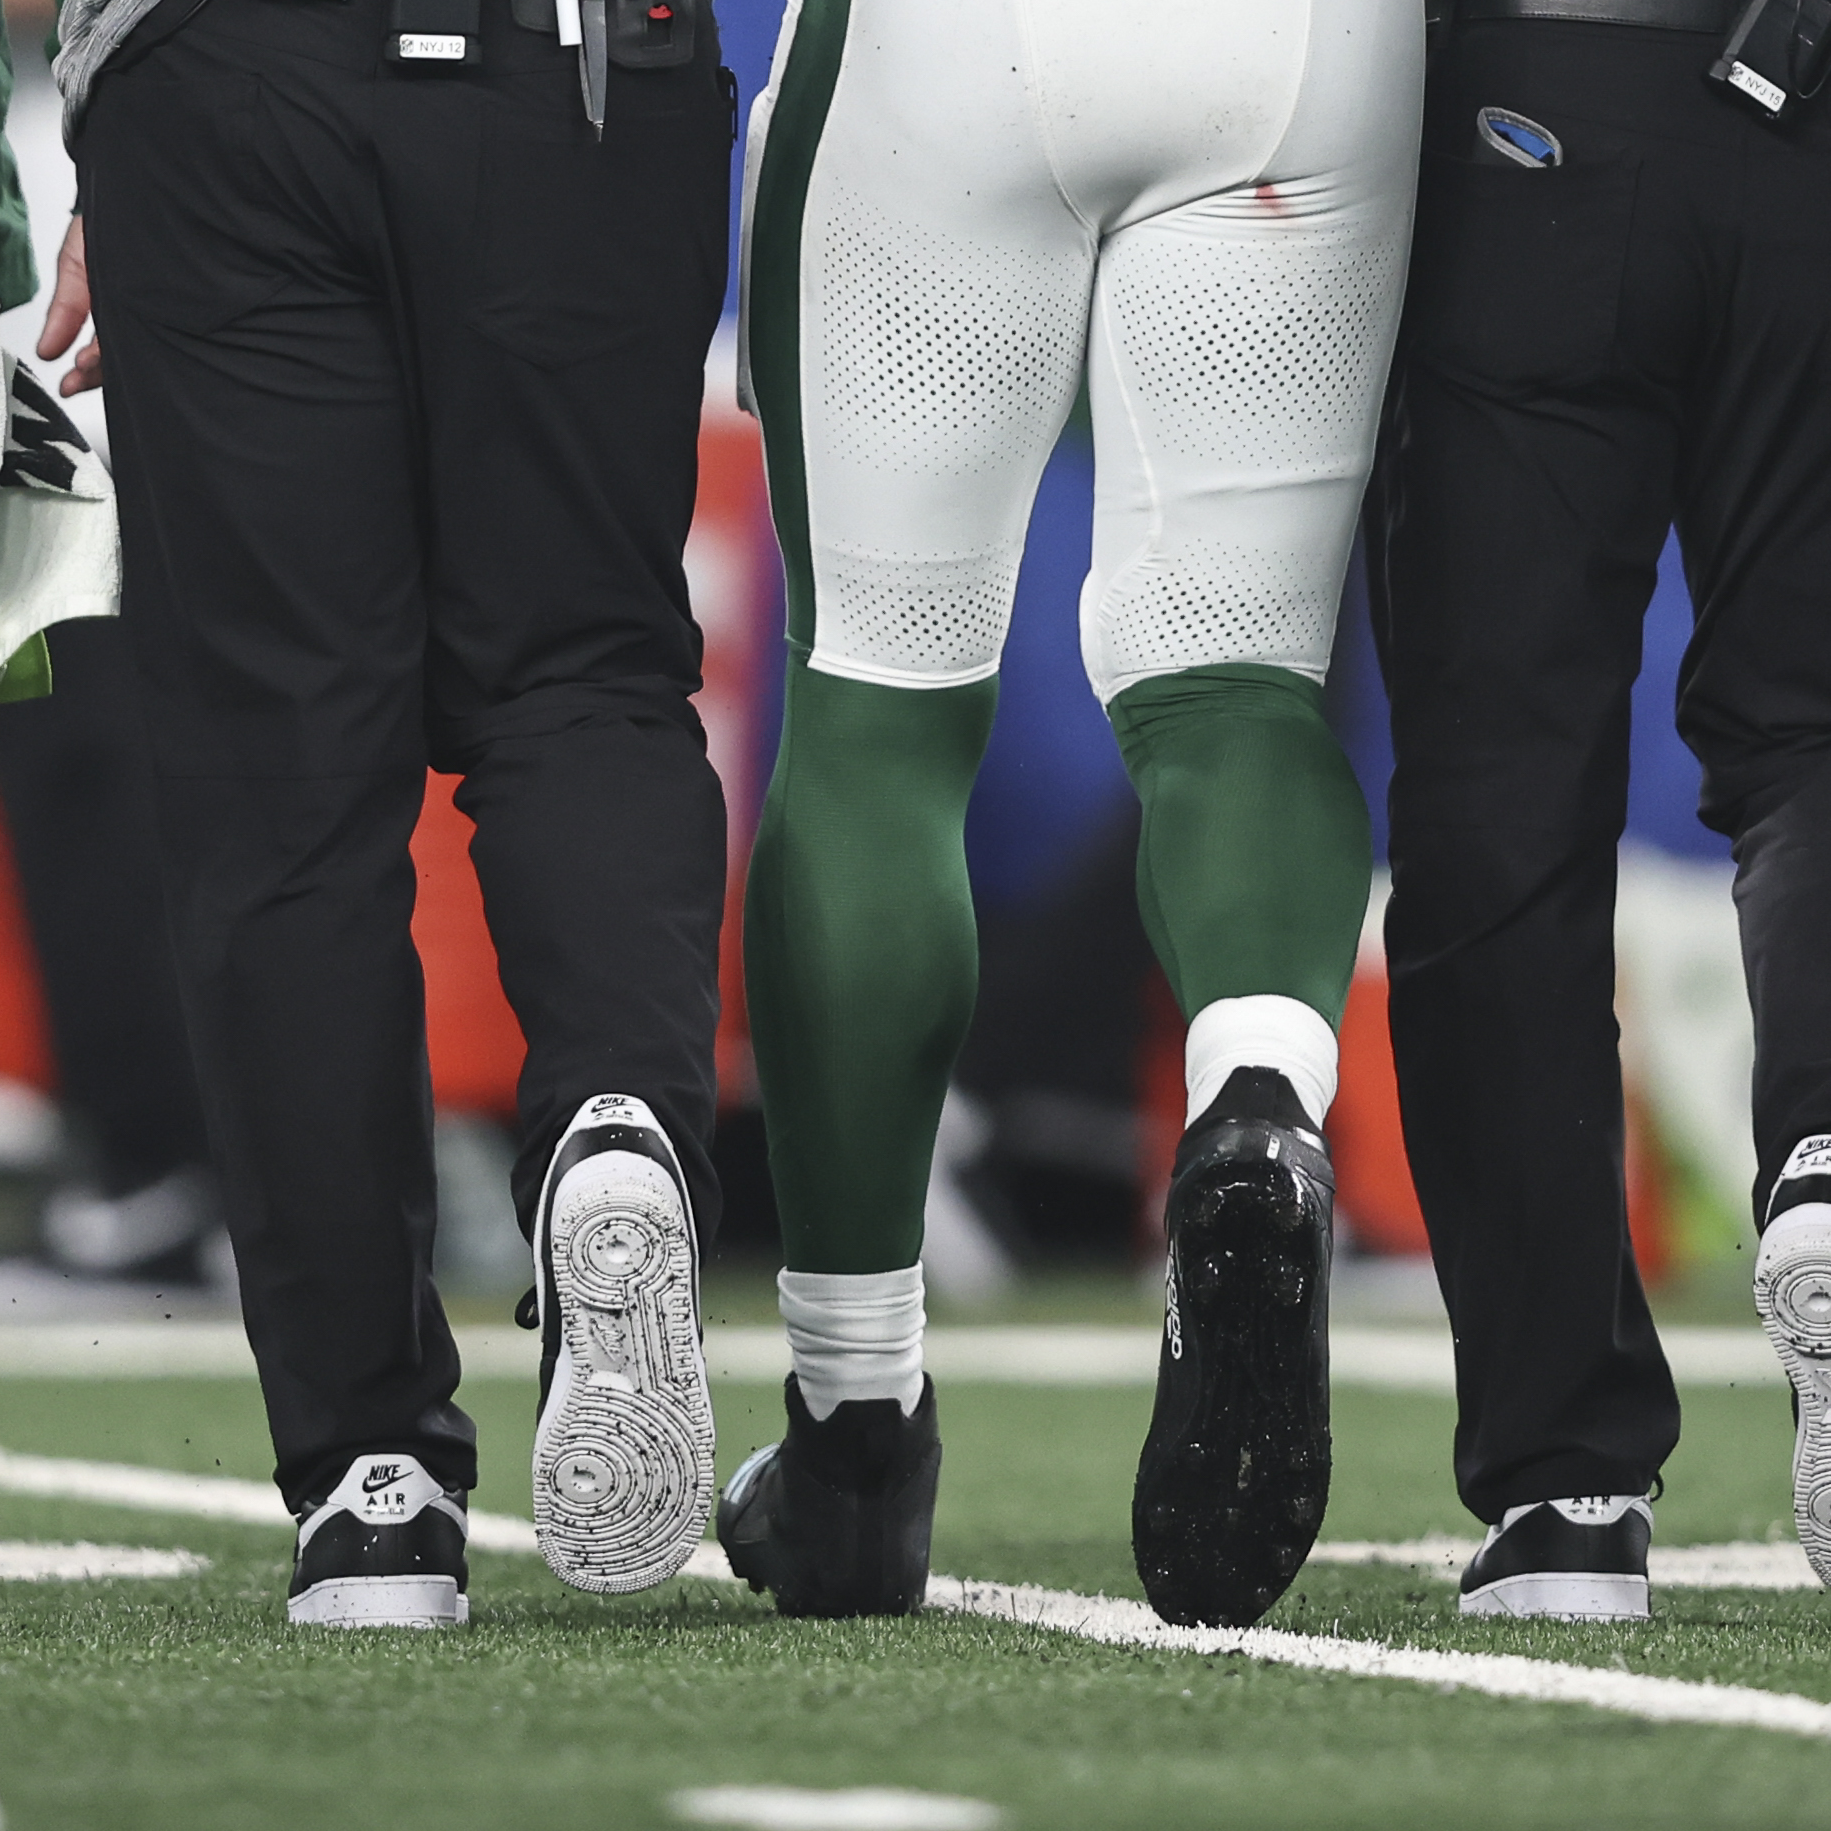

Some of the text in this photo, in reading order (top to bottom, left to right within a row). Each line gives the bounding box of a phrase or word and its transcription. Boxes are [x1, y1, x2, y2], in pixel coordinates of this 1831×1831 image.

[419, 41, 444, 53] NYJ
[449, 42, 462, 53] 12
[1745, 76, 1782, 106] NYJ 15
[368, 1464, 401, 1481] NIKE
[366, 1493, 405, 1506] AIR
